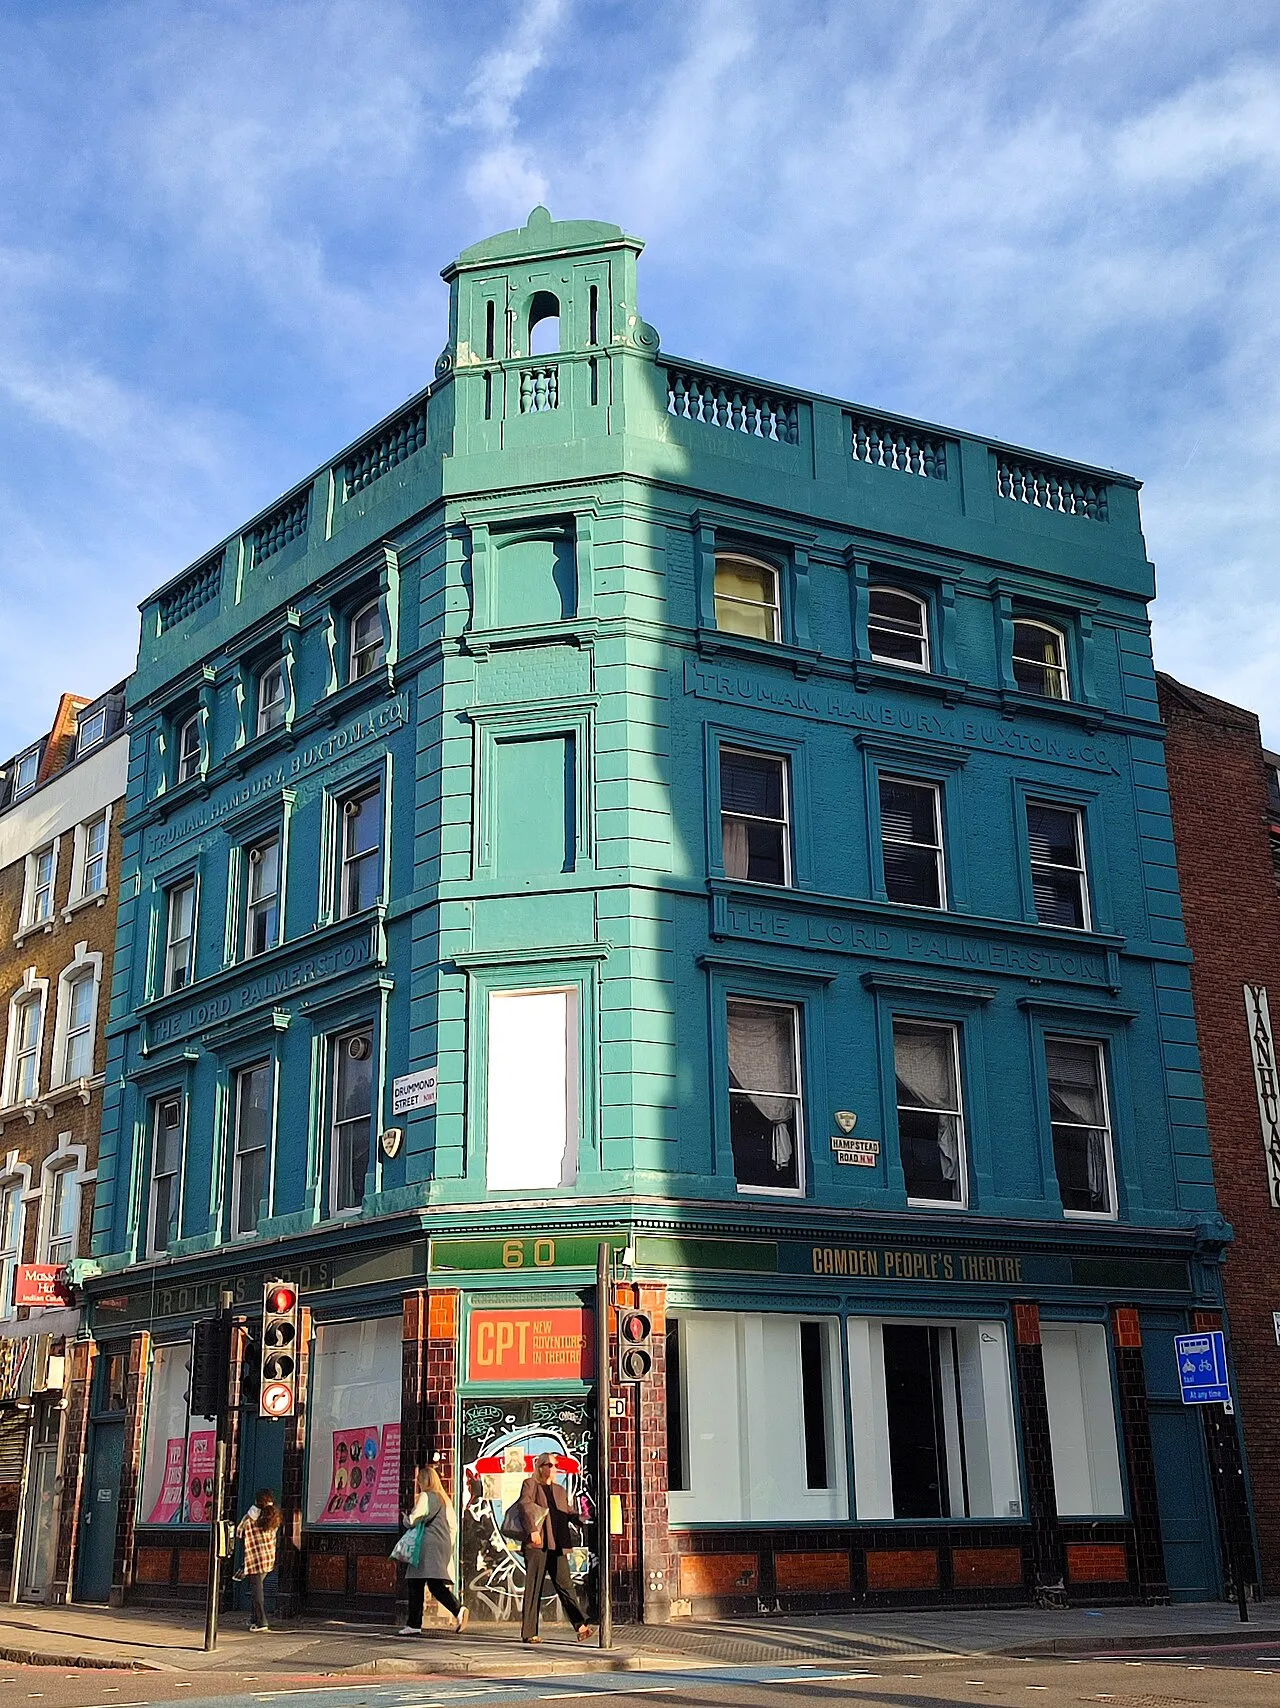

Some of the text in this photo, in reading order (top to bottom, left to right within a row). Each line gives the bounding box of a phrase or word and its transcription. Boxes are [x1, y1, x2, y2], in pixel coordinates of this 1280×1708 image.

[961, 720, 1061, 757] BUXTON
[727, 908, 790, 938] THE
[806, 918, 890, 950] LORD
[152, 1010, 183, 1043] THE
[188, 994, 232, 1030] LORD
[394, 1077, 435, 1098] DRUMMOND
[394, 1094, 419, 1111] STREET
[832, 1138, 878, 1152] HAMPSTEAD
[839, 1152, 859, 1163] ROAD
[502, 1239, 555, 1268] 60
[812, 1247, 1023, 1283] CAMDEN PEOPLE'S THEATRE
[37, 1282, 55, 1294] Hut
[533, 1320, 552, 1334] NEW
[476, 1320, 530, 1366] CPT
[533, 1335, 587, 1350] ADVENTURES
[533, 1350, 580, 1365] IN THEATRE
[1189, 1390, 1222, 1399] At any time
